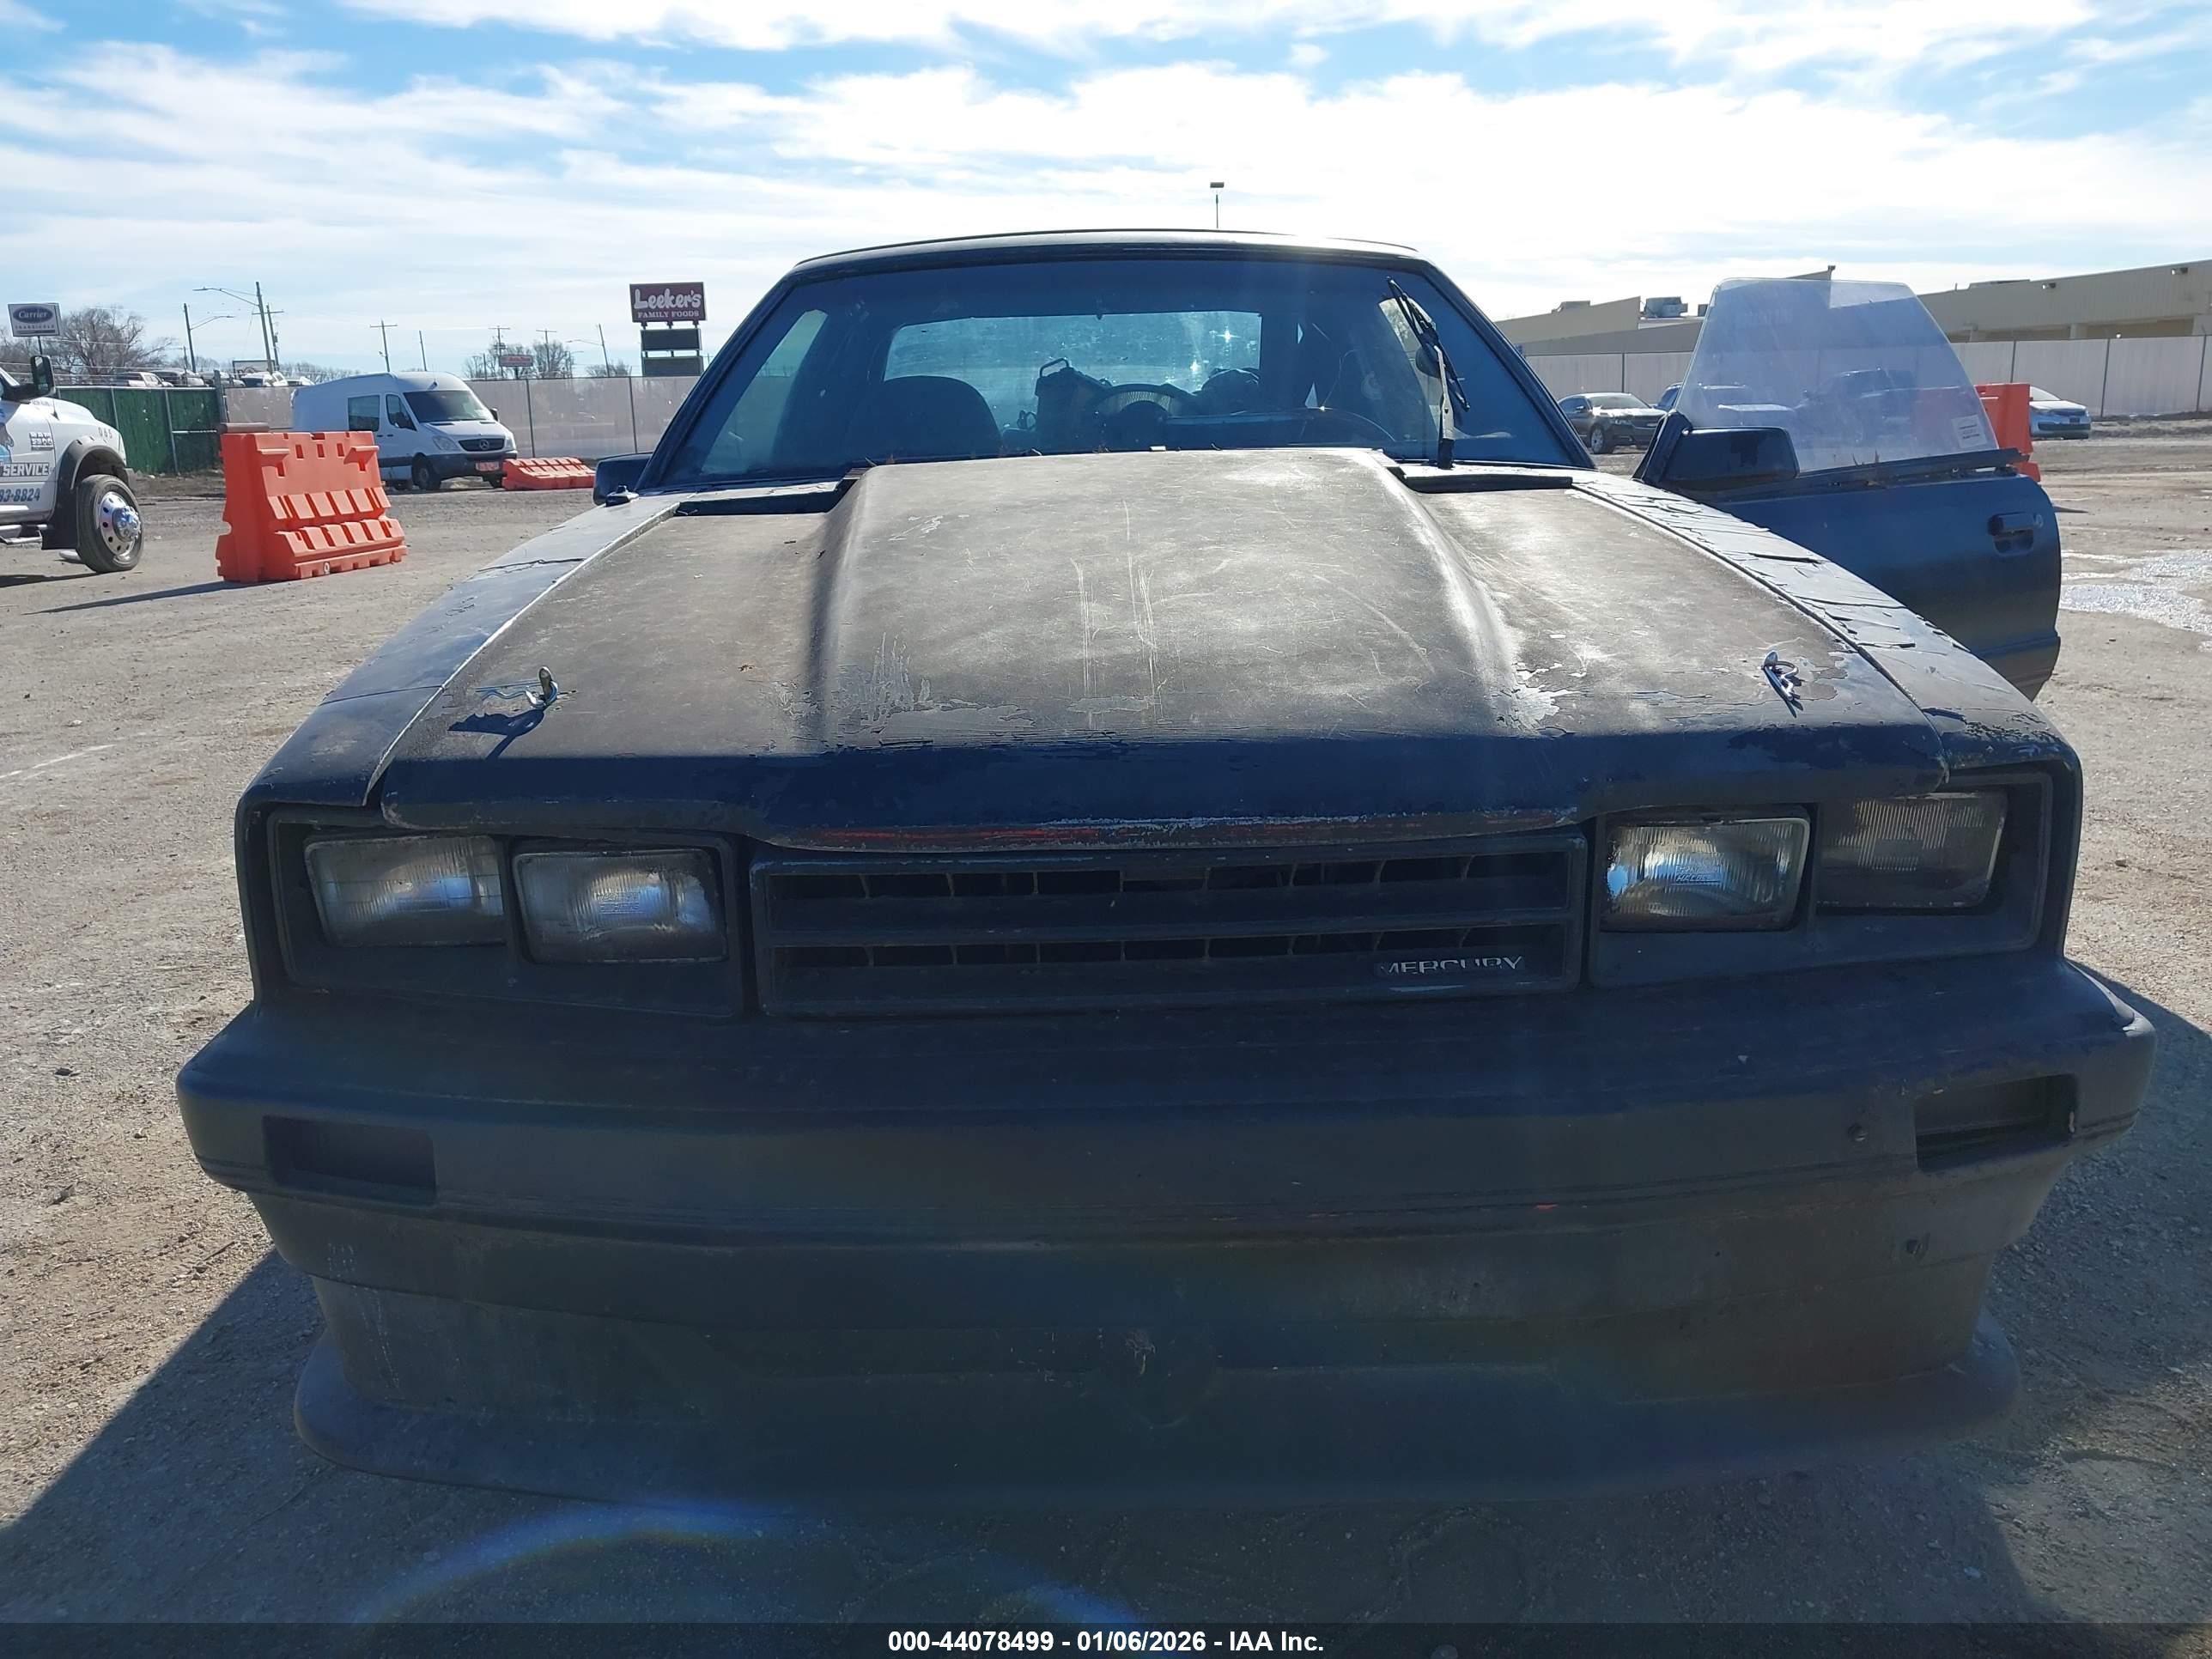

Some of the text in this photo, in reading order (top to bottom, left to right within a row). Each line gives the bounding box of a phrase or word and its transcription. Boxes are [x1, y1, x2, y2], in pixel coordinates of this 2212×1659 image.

[634, 288, 702, 309] Leeker's
[18, 309, 49, 319] Carrier
[3, 463, 49, 476] SERVICE
[1380, 956, 1522, 976] MERCURY
